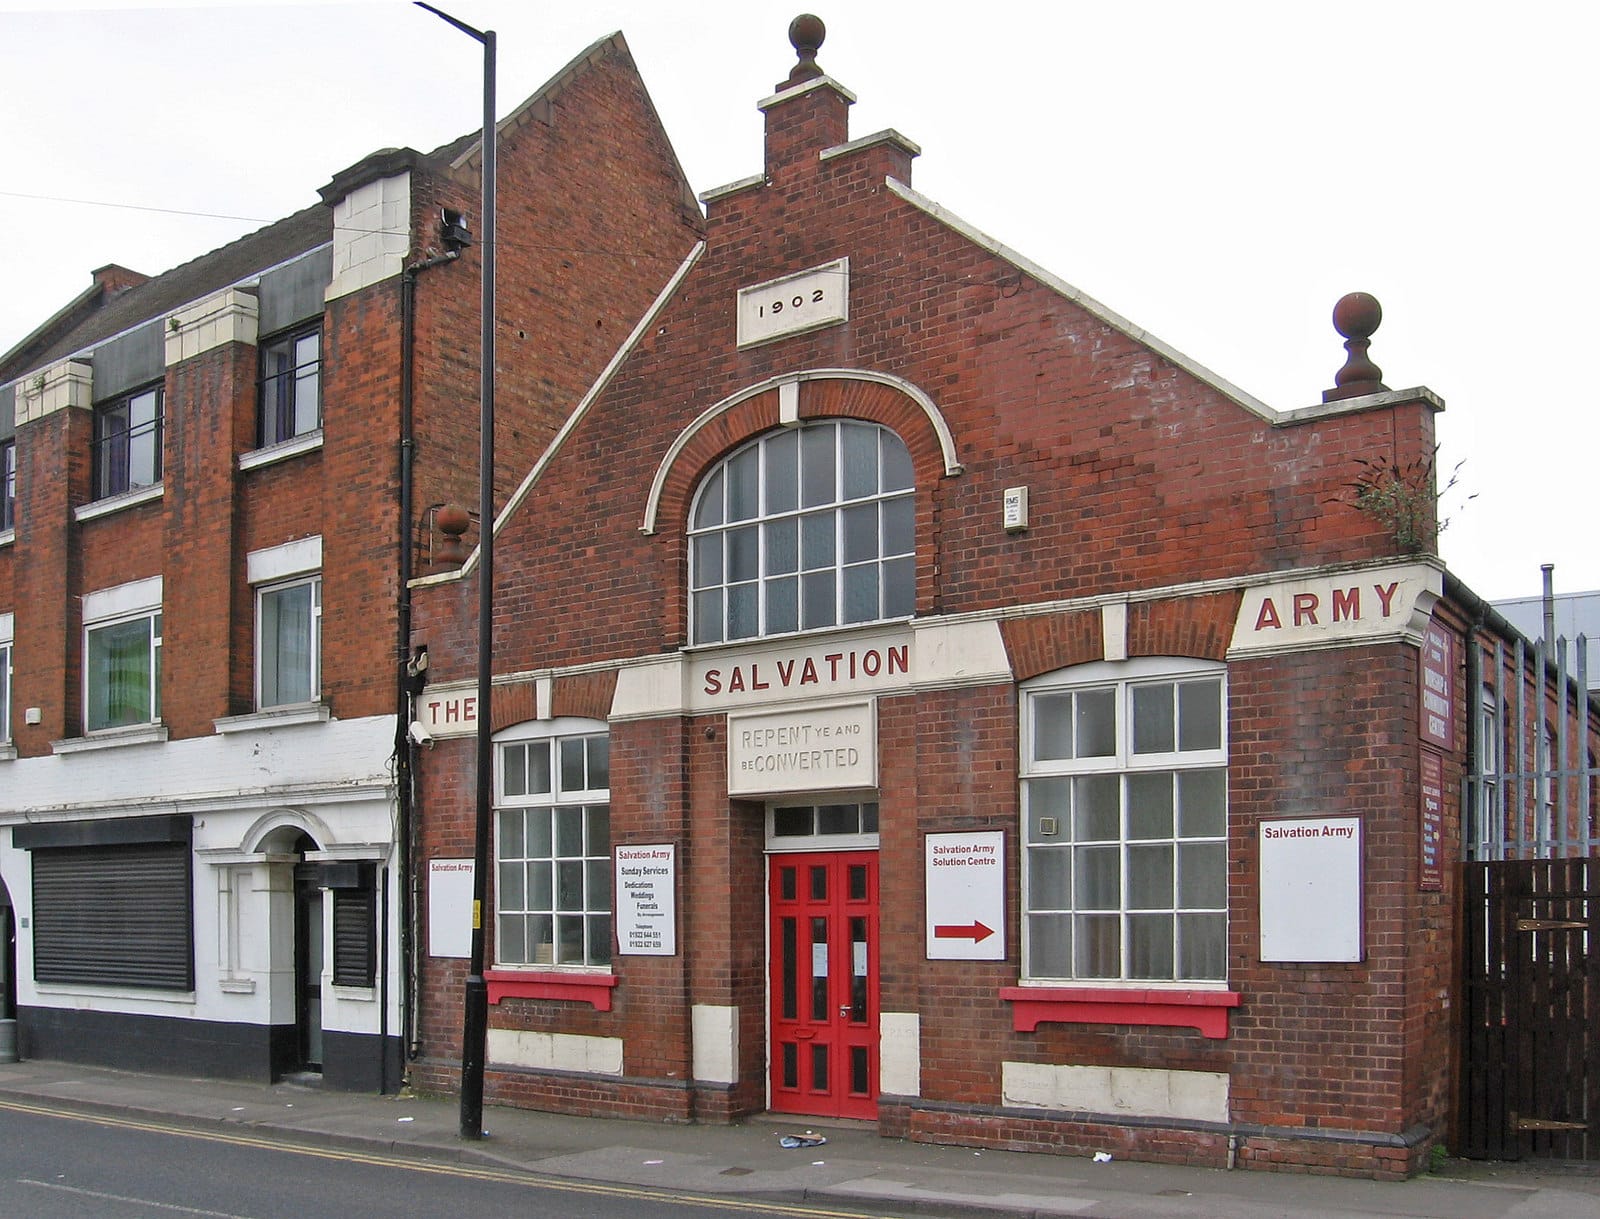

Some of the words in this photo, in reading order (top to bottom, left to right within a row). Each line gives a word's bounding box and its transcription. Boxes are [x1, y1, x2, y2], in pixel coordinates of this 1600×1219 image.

[759, 289, 823, 318] 1902
[428, 697, 476, 725] THE
[704, 645, 909, 695] SALVATION
[1255, 582, 1399, 631] ARMY
[742, 725, 812, 749] REPENT
[815, 727, 830, 737] YE
[835, 724, 861, 735] AND
[741, 760, 754, 770] BE
[754, 747, 859, 772] CONVERTED
[1265, 826, 1319, 839] Salvation
[1322, 825, 1354, 839] Army
[619, 851, 650, 860] Salvation
[652, 850, 670, 860] Army
[933, 845, 971, 855] Salvation
[973, 844, 995, 855] Army
[933, 857, 967, 867] Solution
[968, 856, 996, 866] Centre
[431, 863, 457, 872] Salvation
[458, 863, 473, 873] Army
[621, 867, 641, 877] Sunday
[642, 866, 669, 876] Services
[624, 881, 654, 889] Dedications
[631, 891, 654, 901] Weddings
[636, 901, 658, 910] Funerals
